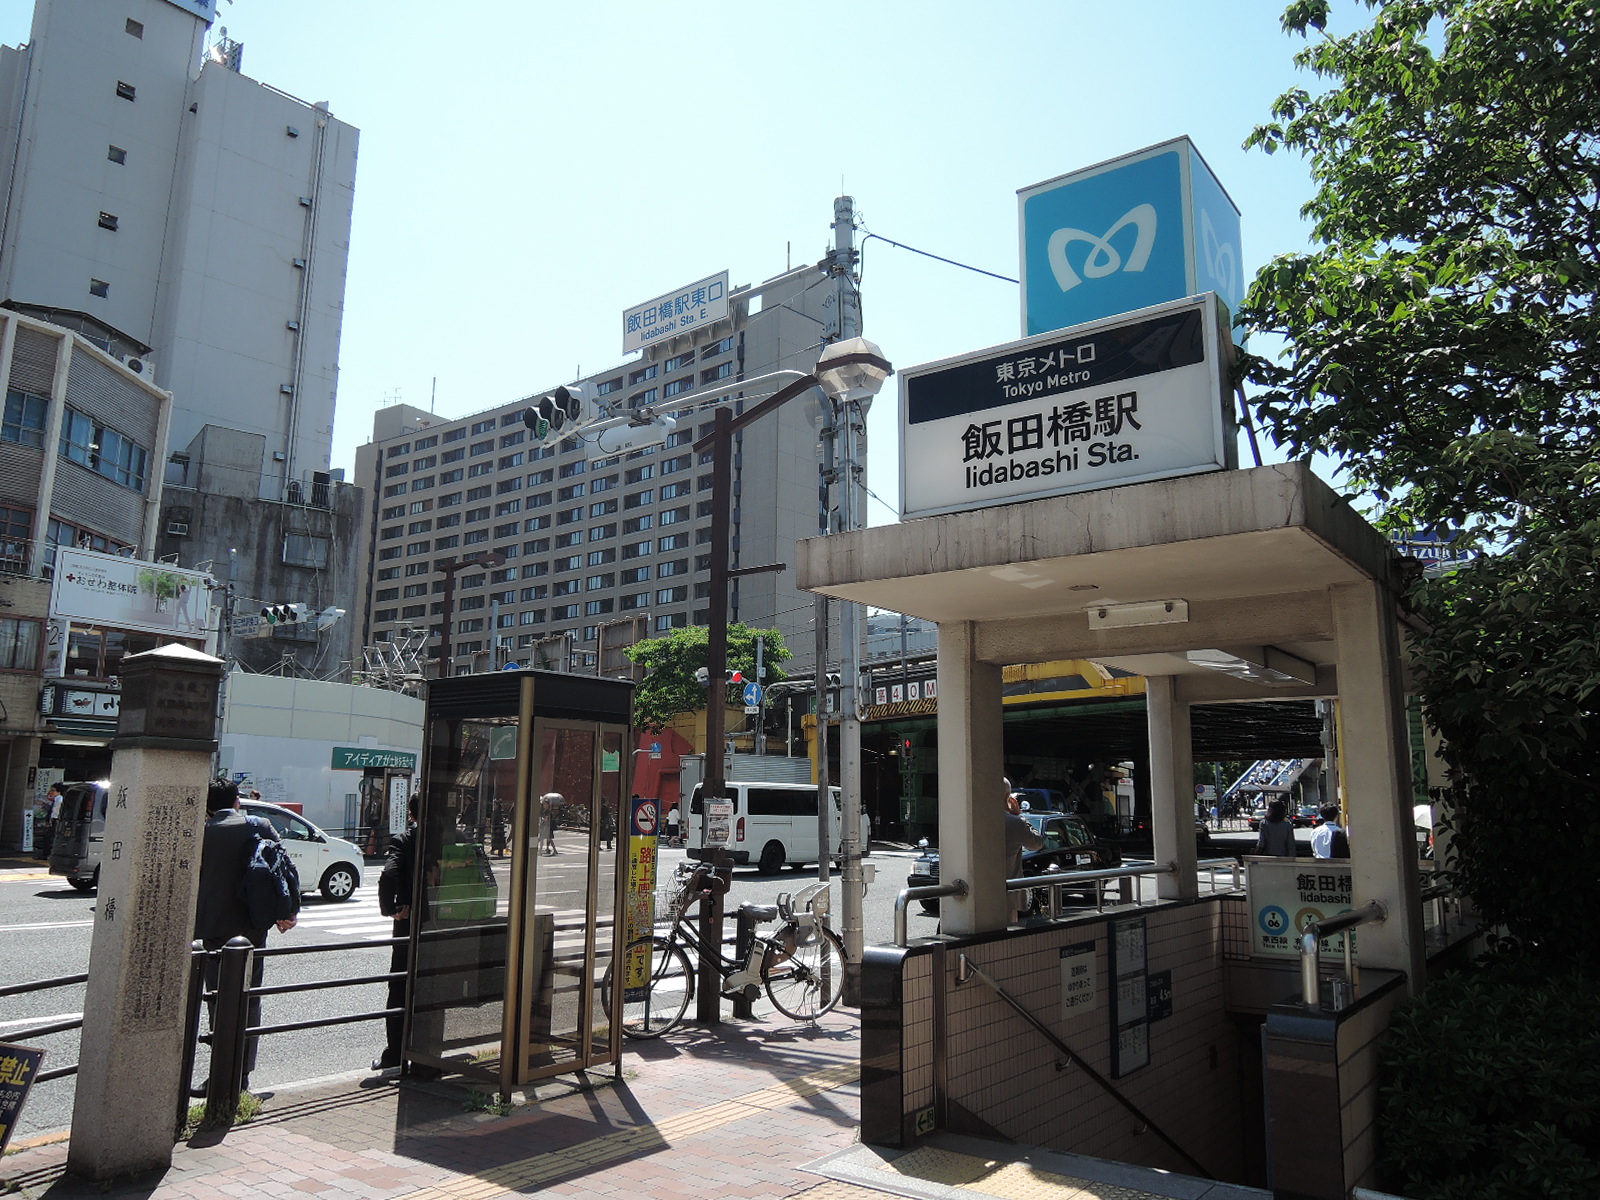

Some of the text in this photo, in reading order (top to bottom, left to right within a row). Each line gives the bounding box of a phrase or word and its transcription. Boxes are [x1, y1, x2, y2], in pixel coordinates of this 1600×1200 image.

[626, 280, 723, 335] 飯田橋駅東口
[640, 308, 709, 342] Iidabashi Sta. E.
[995, 342, 1096, 384] 東京メトロ
[1002, 369, 1091, 399] Tokyo Metro
[960, 391, 1143, 465] 飯田橋駅
[964, 440, 1140, 489] Iidabashi Sta.
[1300, 892, 1352, 904] Iidabashi
[1267, 919, 1280, 928] 06
[1262, 935, 1288, 945] 東西線
[0, 1056, 31, 1086] 禁止
